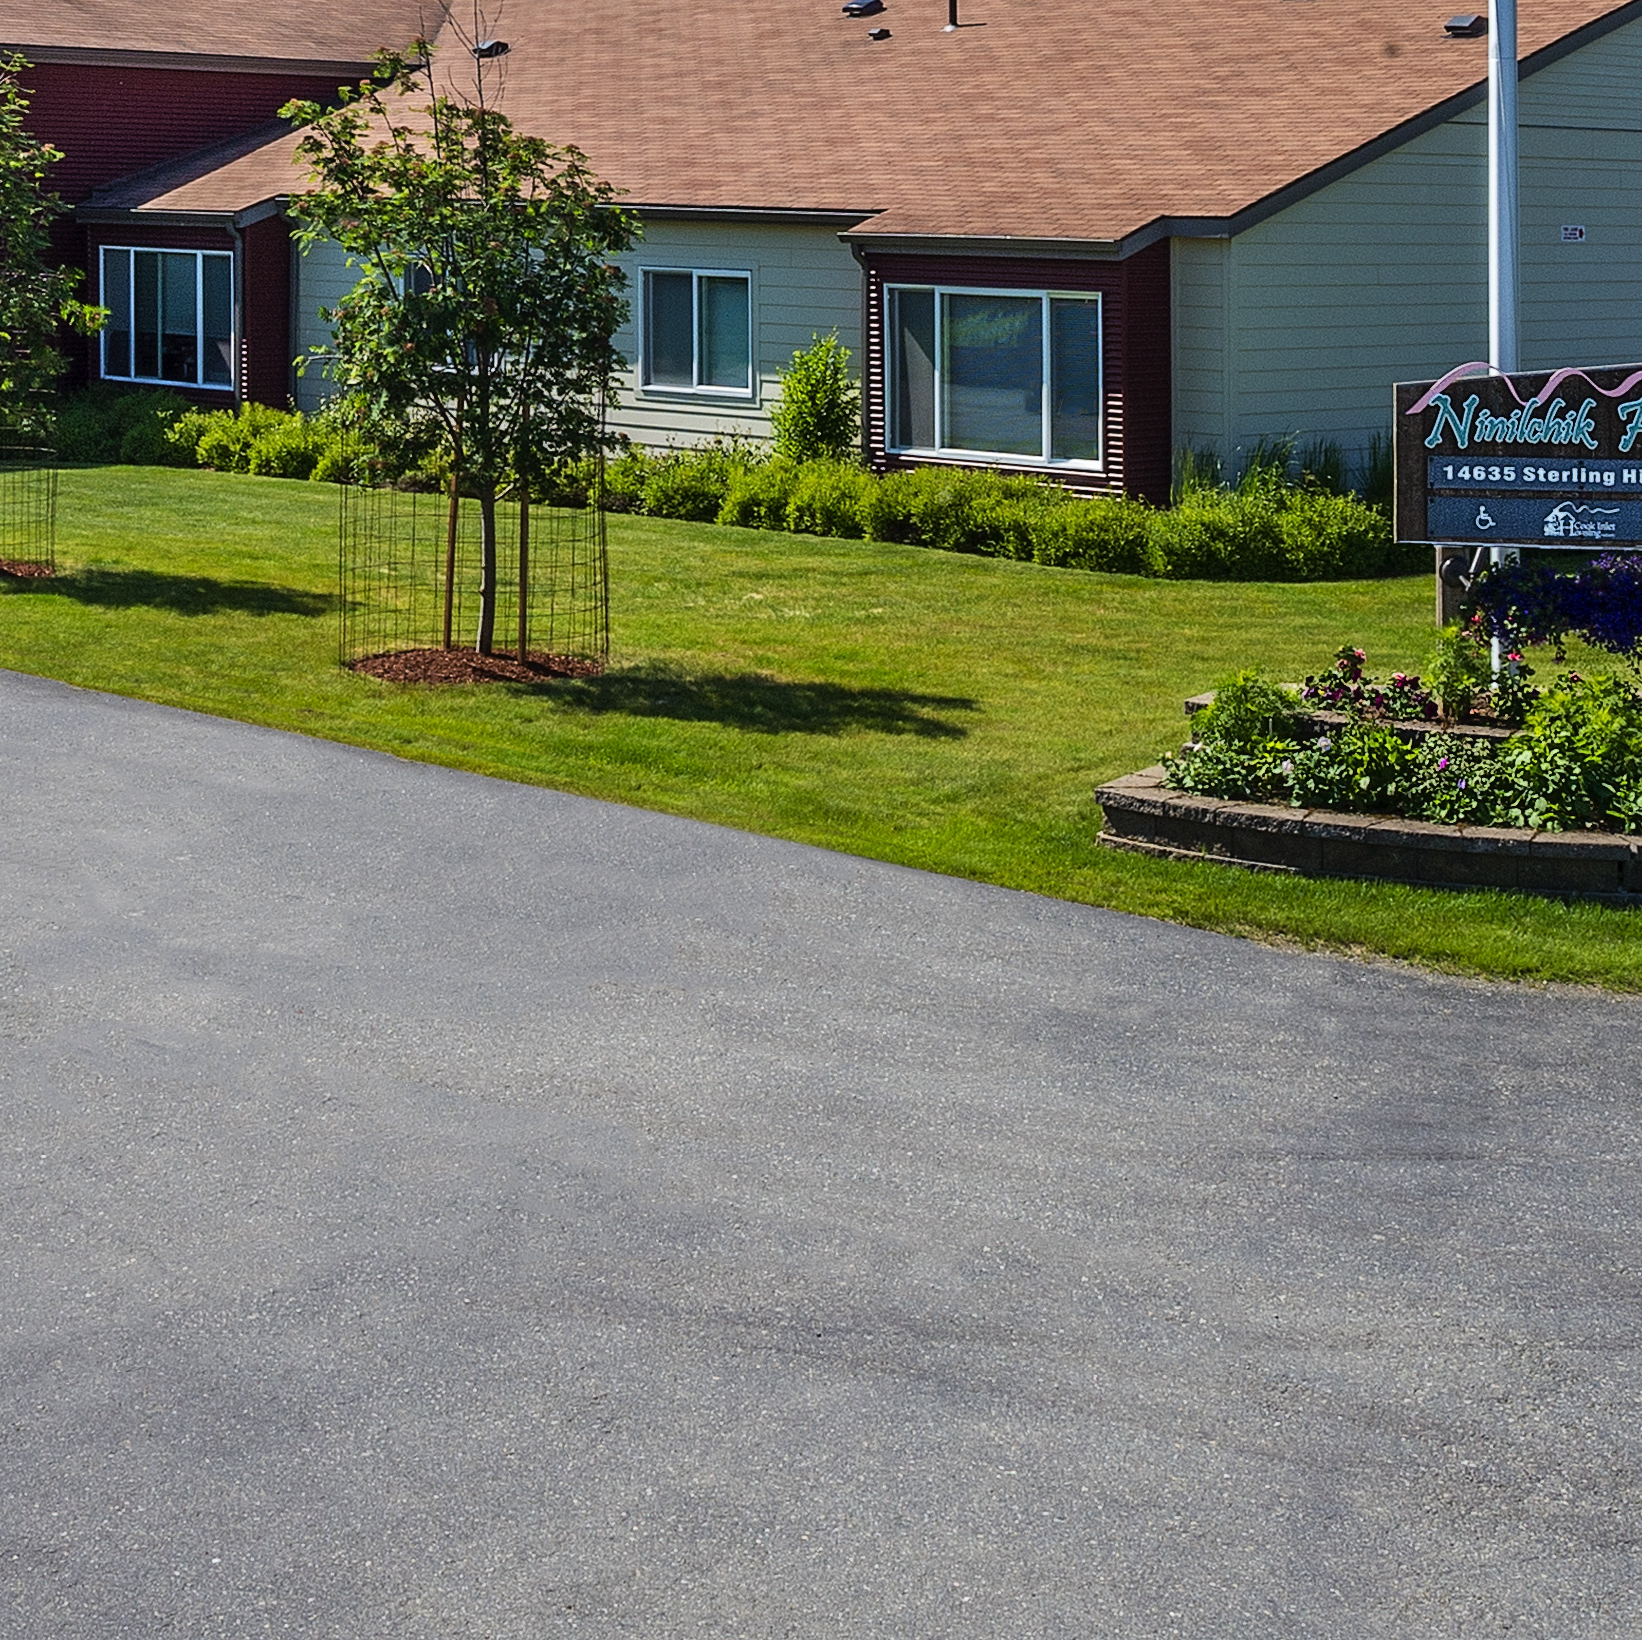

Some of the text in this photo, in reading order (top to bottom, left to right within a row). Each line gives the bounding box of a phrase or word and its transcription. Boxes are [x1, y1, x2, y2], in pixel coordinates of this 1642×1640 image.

[1424, 393, 1599, 450] Ninilchik
[1443, 465, 1516, 481] 14635
[1522, 467, 1616, 487] Sterling
